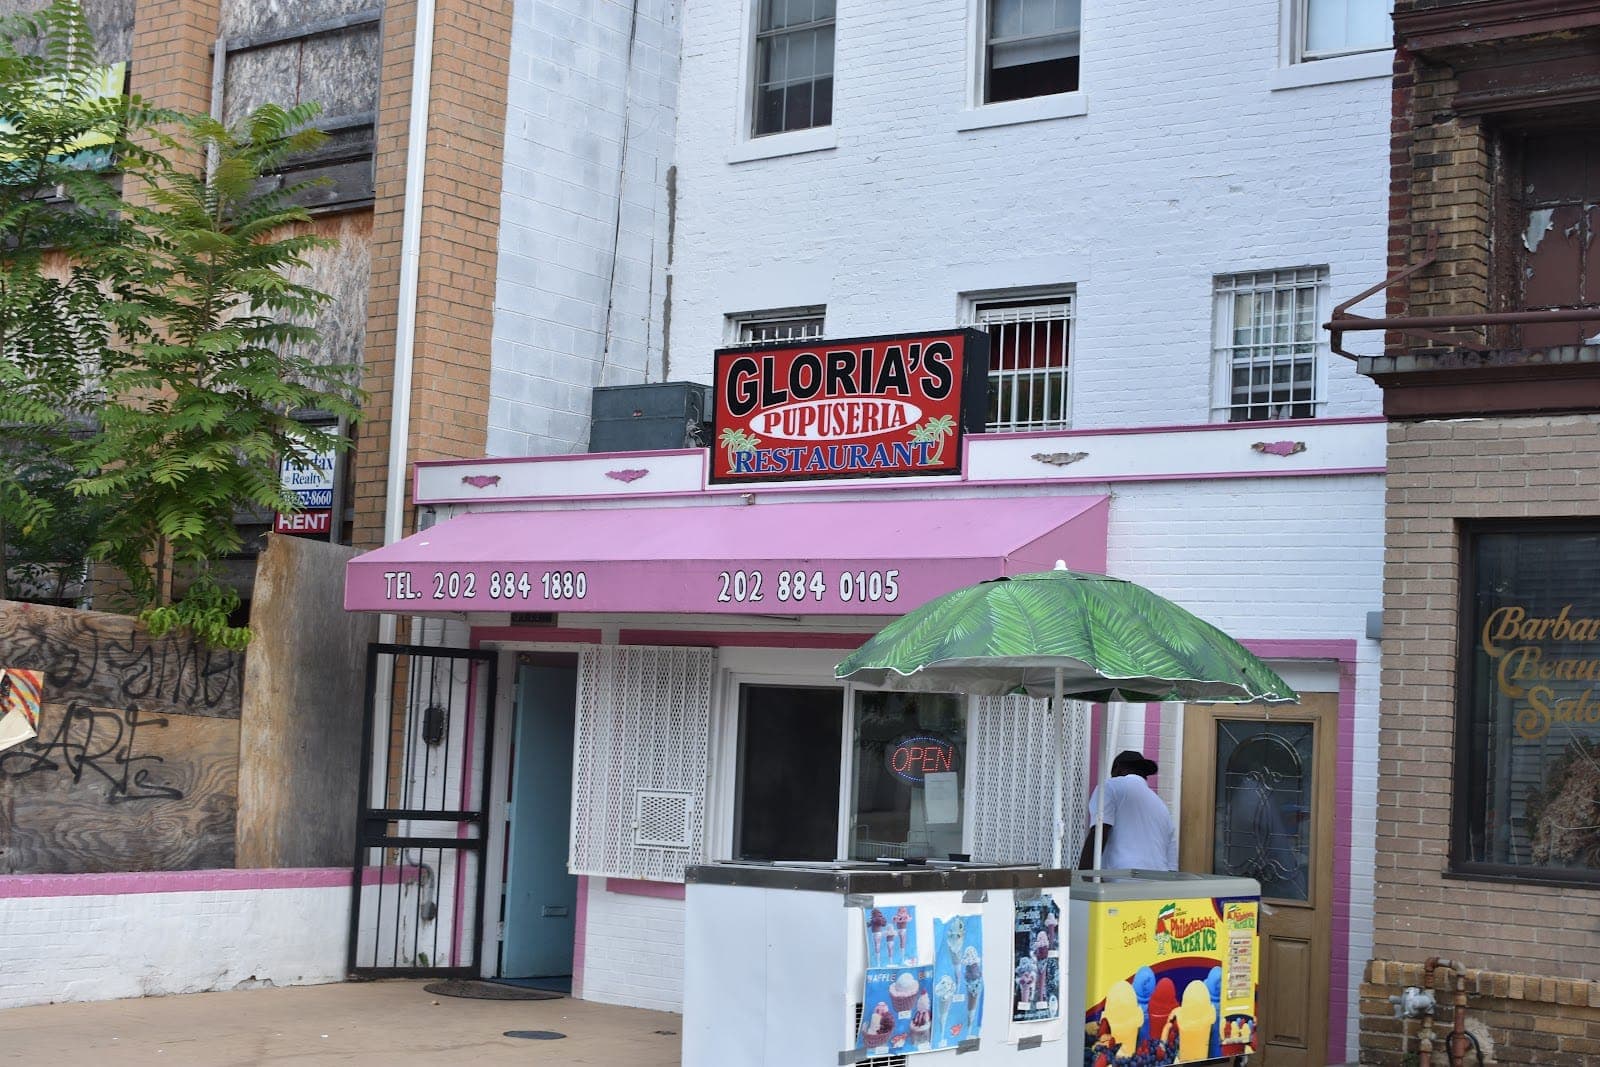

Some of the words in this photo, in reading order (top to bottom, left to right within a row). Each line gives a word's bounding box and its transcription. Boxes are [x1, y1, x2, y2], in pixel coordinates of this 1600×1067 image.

[726, 341, 953, 417] GLORIA'S
[763, 402, 908, 438] PUPUSERIA
[735, 441, 935, 474] RESTAURANT
[292, 473, 321, 487] Realty
[278, 514, 329, 530] RENT
[384, 572, 423, 599] TEL.
[433, 572, 477, 600] 202
[489, 571, 531, 599] 884
[541, 571, 587, 600] 1880
[718, 570, 764, 602] 202
[777, 570, 826, 601] 884
[839, 569, 899, 602] 0105
[1498, 646, 1600, 698] Beau
[891, 745, 954, 772] OPEN
[1170, 916, 1215, 938] Philadelphia
[1170, 931, 1200, 953] WATER
[1202, 928, 1216, 951] ICE
